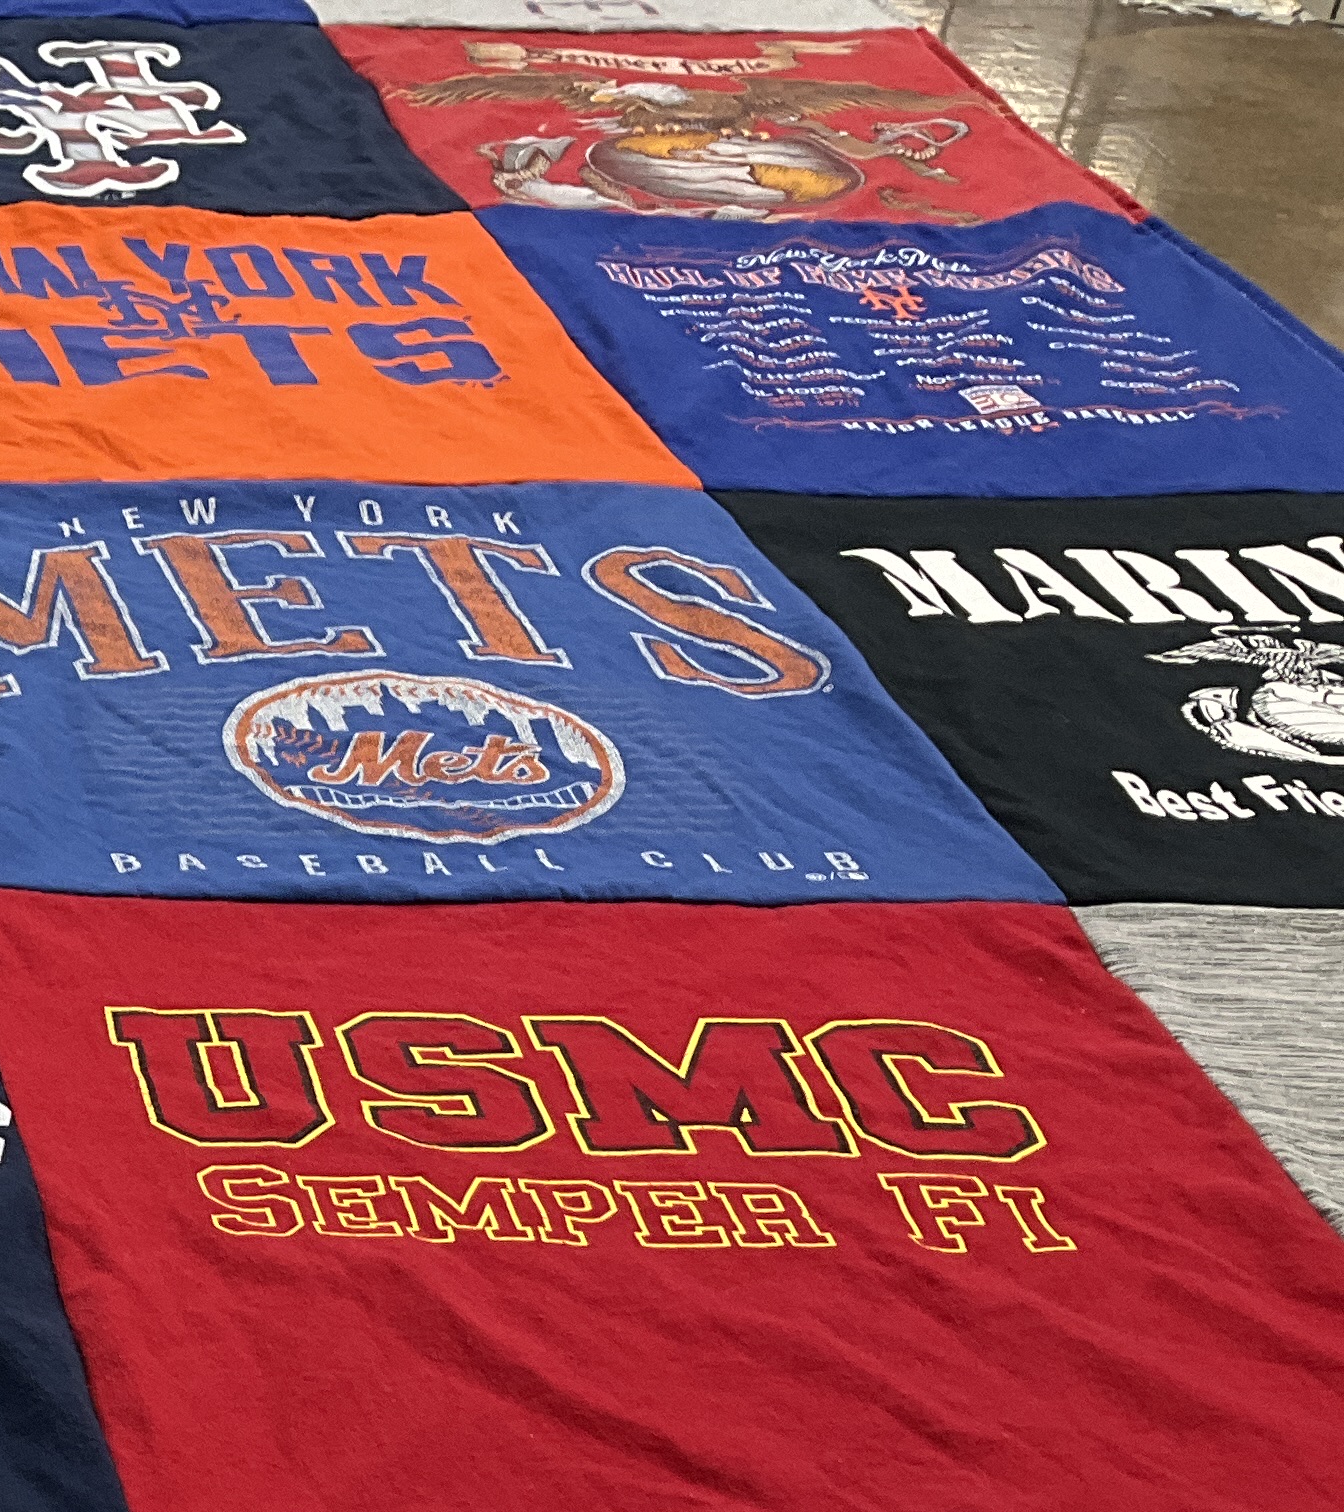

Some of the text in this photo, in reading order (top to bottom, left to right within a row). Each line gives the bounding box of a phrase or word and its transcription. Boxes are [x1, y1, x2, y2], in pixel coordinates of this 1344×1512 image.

[119, 237, 464, 309] YORK
[944, 411, 1051, 432] LEAGUE
[57, 496, 525, 538] NEW YORK
[308, 730, 550, 787] Mets
[1112, 769, 1256, 821] Best
[111, 848, 860, 877] BASEBALL CLUB
[103, 1005, 1048, 1164] USMC
[196, 1163, 1078, 1254] SEMPER FI
